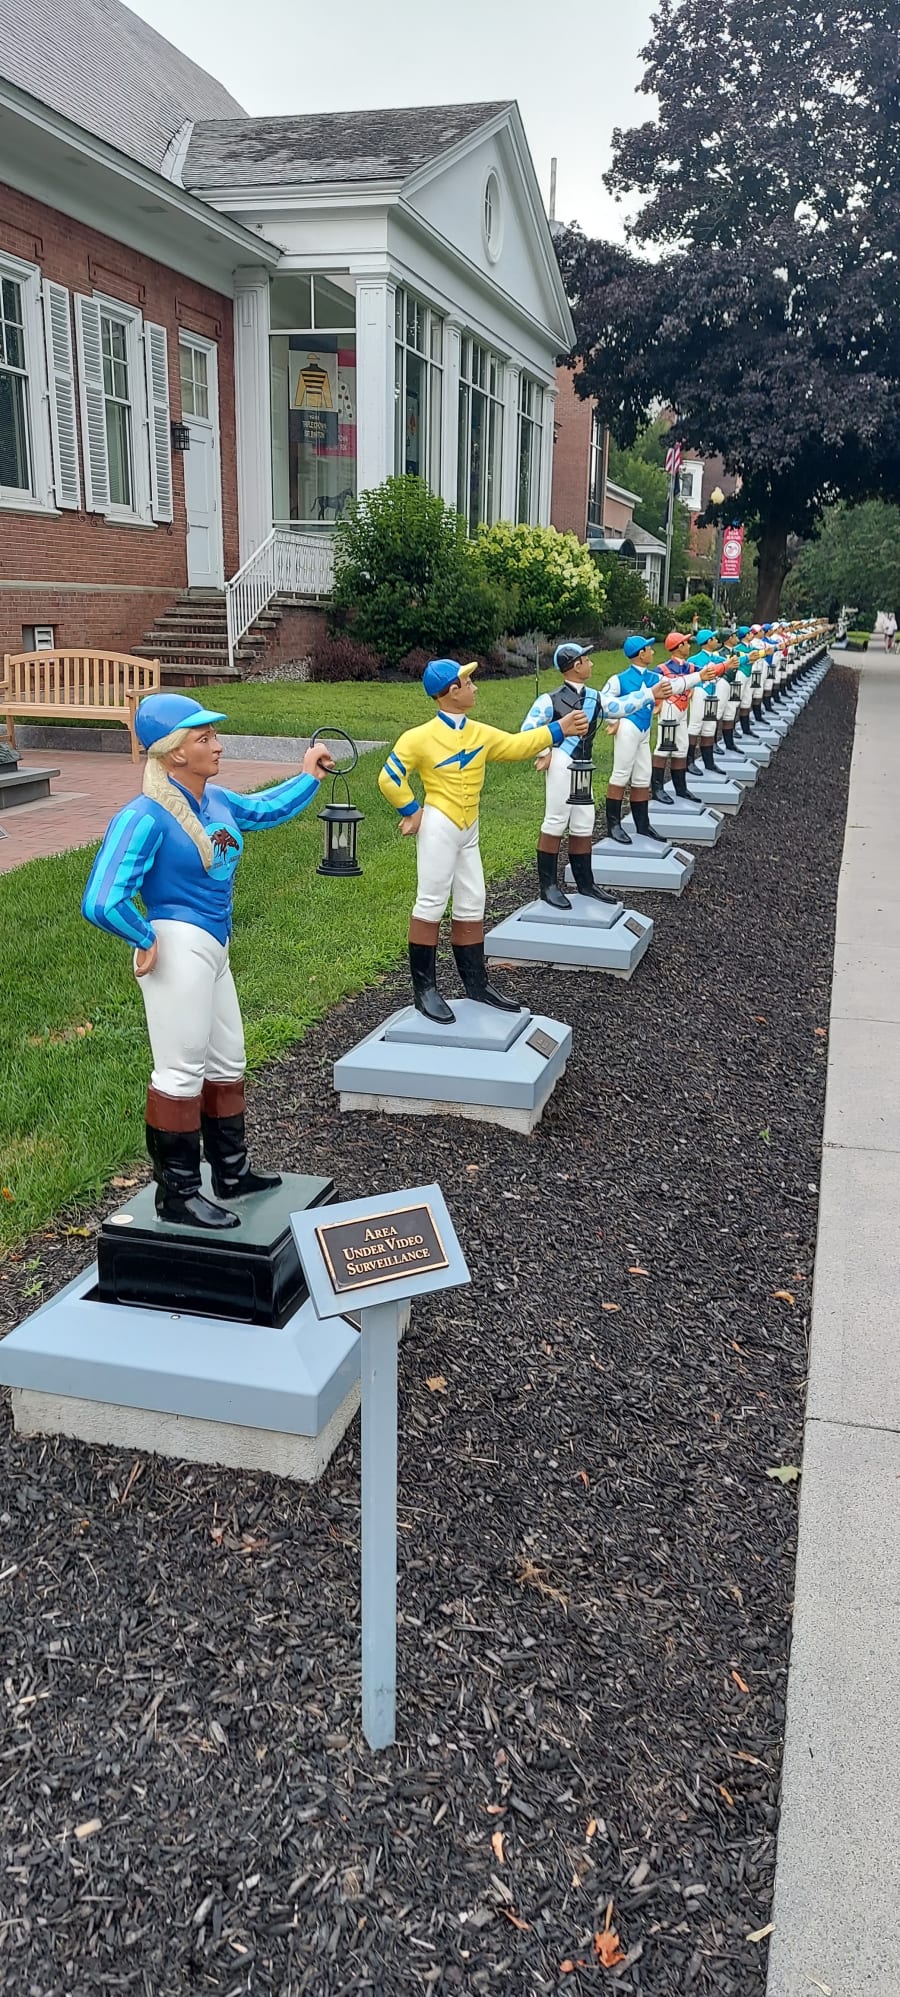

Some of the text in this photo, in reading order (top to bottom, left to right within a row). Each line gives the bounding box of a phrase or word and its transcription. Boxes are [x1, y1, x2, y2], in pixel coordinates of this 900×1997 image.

[364, 1227, 398, 1241] AREA
[342, 1235, 424, 1261] UNDER VIDEO
[346, 1248, 431, 1276] SURVEILLANCE
